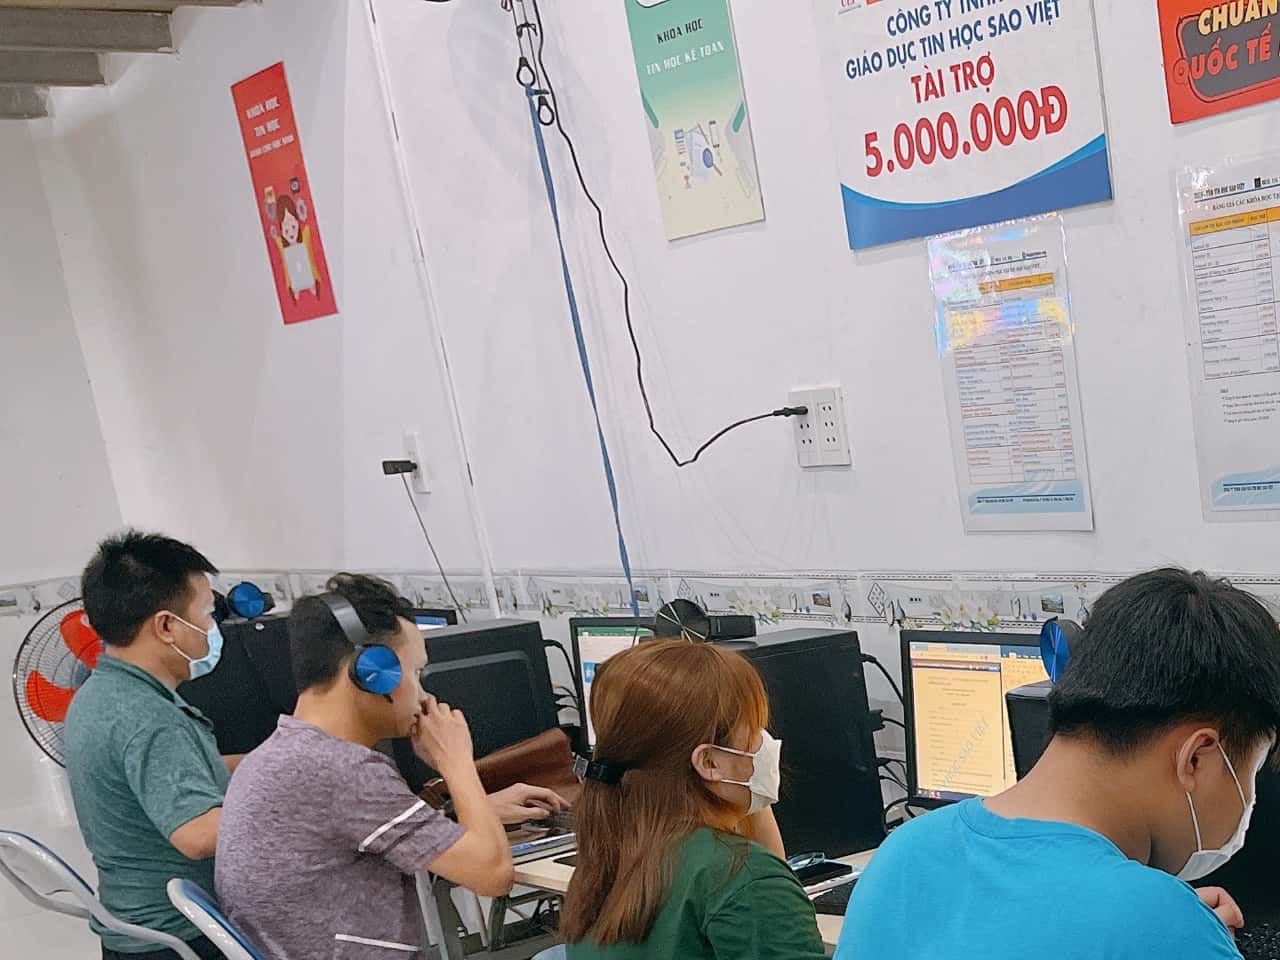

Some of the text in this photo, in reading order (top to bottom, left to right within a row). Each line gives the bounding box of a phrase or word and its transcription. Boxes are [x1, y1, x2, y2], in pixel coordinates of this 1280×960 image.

[886, 5, 932, 37] CÔNG
[935, 0, 952, 21] TY
[886, 41, 918, 70] DỤC
[919, 31, 946, 58] TIN
[949, 19, 985, 50] HỌC
[988, 9, 1023, 38] SAO
[910, 51, 996, 104] TÀI TRỢ
[1172, 37, 1239, 85] QUỐC
[1247, 22, 1273, 65] TẾ
[864, 84, 1069, 178] 5.000.000Đ
